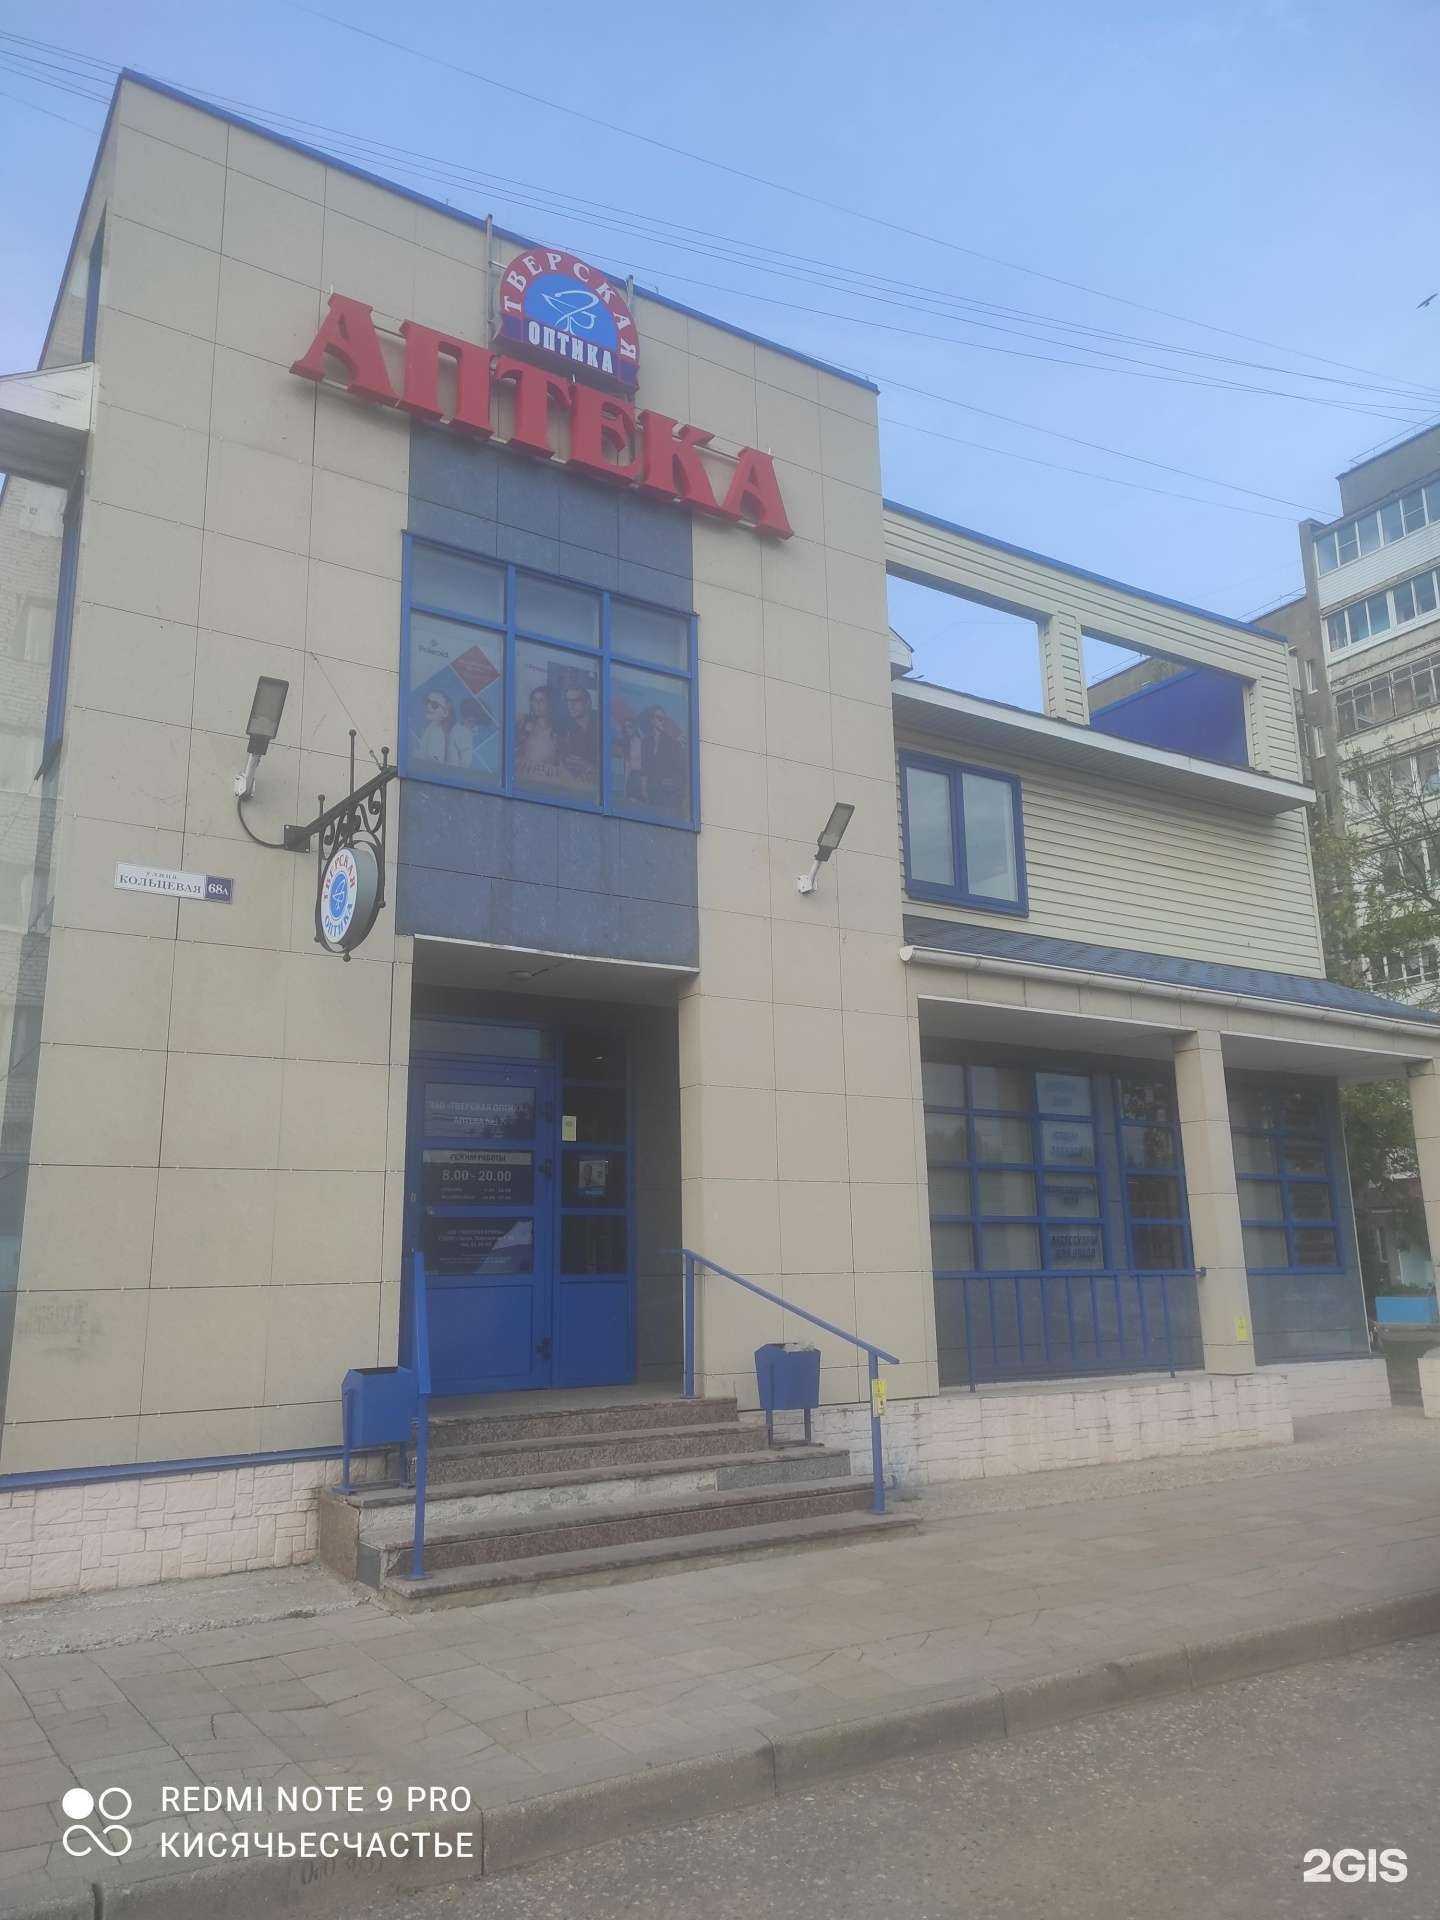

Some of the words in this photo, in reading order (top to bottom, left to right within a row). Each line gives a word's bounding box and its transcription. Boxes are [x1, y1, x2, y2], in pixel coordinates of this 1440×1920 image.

[503, 252, 637, 361] ТВЕРСКАЯ
[527, 319, 614, 375] ОПТИКА
[289, 293, 794, 540] АПТЕКА
[120, 874, 201, 894] КОЛЬЦЕВАЯ
